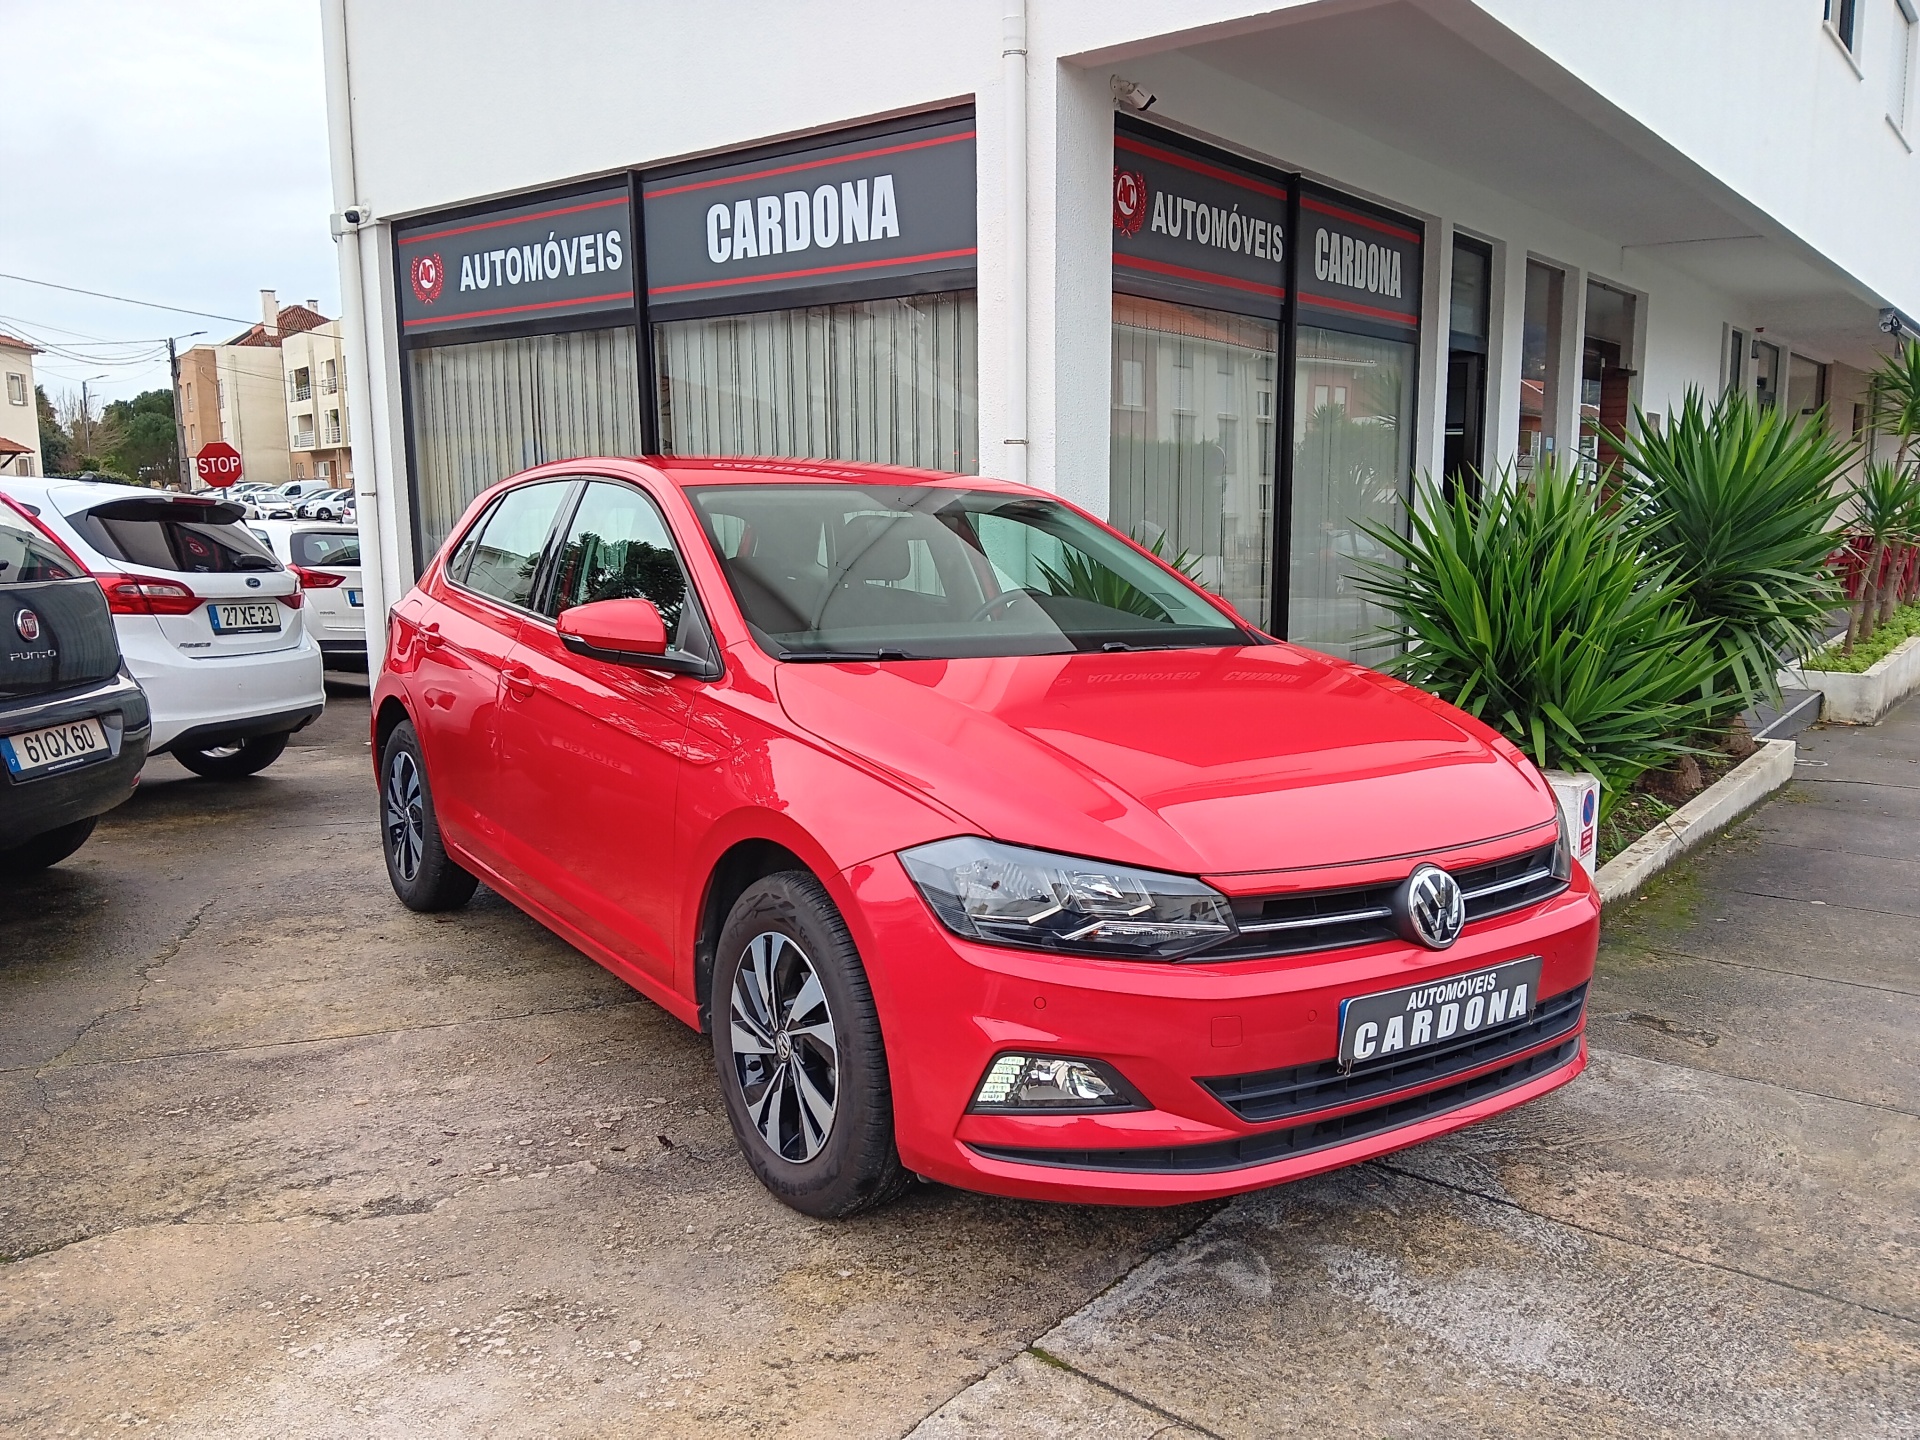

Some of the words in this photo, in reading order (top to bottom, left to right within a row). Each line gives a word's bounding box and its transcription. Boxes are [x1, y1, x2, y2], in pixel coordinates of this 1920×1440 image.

[459, 230, 623, 292] AUTOMÓVEIS
[706, 174, 900, 264] CARDONA
[1151, 191, 1284, 263] AUTOMÓVEIS
[1315, 228, 1402, 298] CARDONA
[198, 456, 240, 474] STOP
[9, 649, 57, 662] PUNTO
[1406, 972, 1497, 1011] AUTOMÓVEIS
[1353, 983, 1528, 1060] CARDONA
